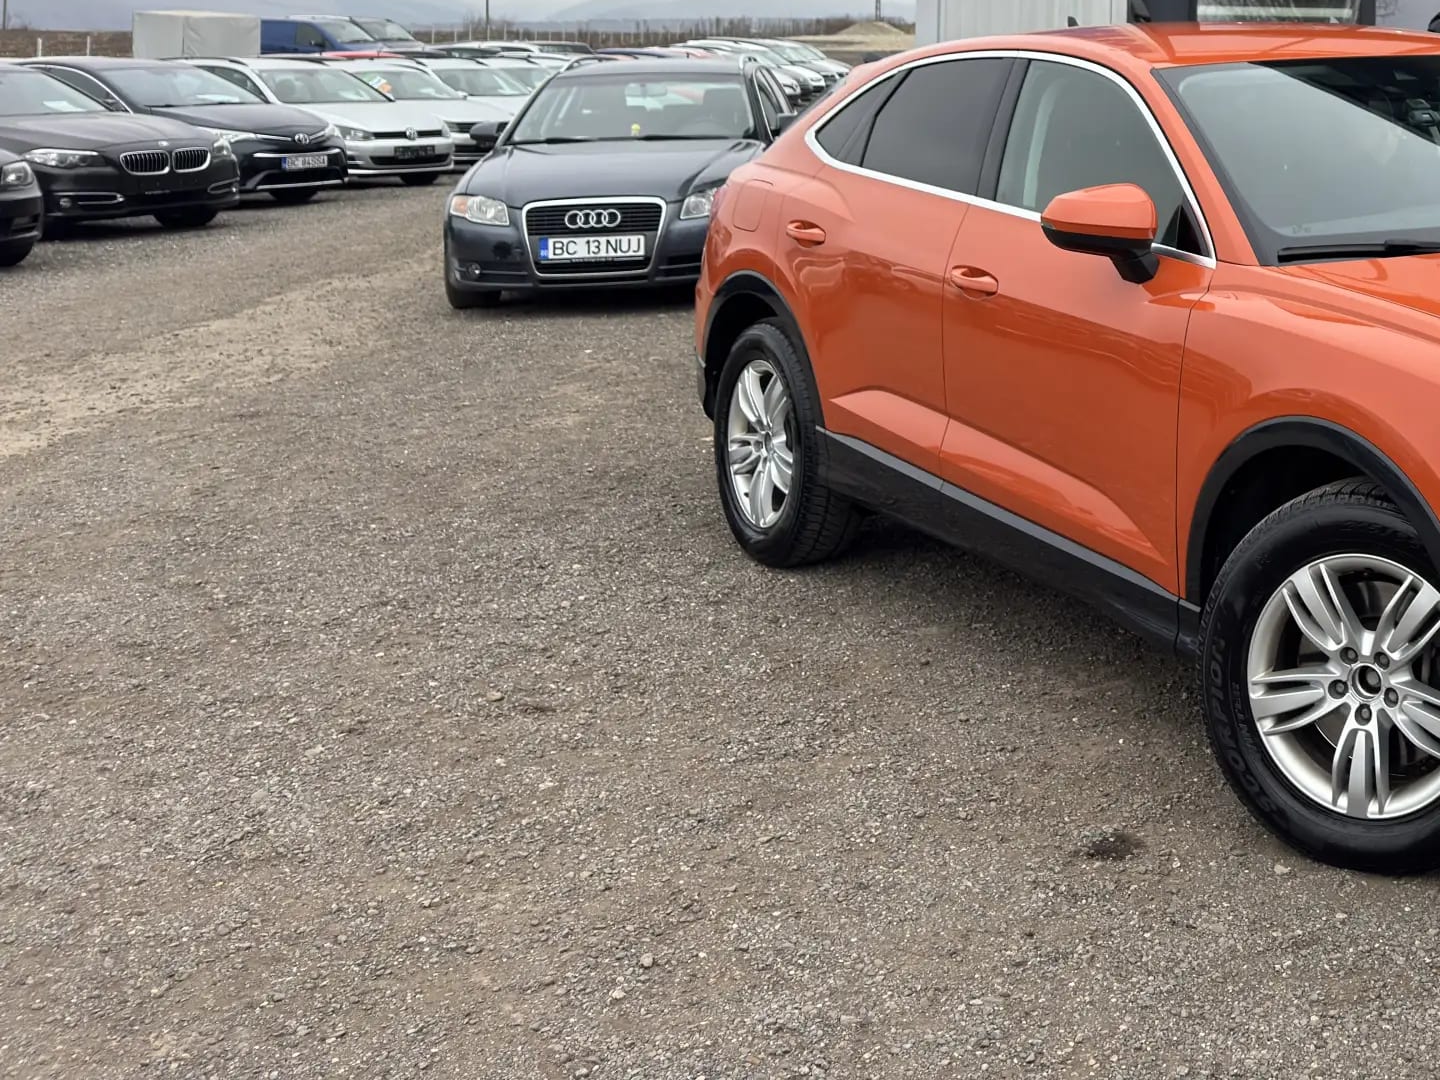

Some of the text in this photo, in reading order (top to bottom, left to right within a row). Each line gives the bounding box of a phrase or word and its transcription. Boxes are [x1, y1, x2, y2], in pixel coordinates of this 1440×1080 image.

[552, 239, 577, 256] BC
[585, 239, 601, 255] 13
[605, 237, 641, 254] NUJ
